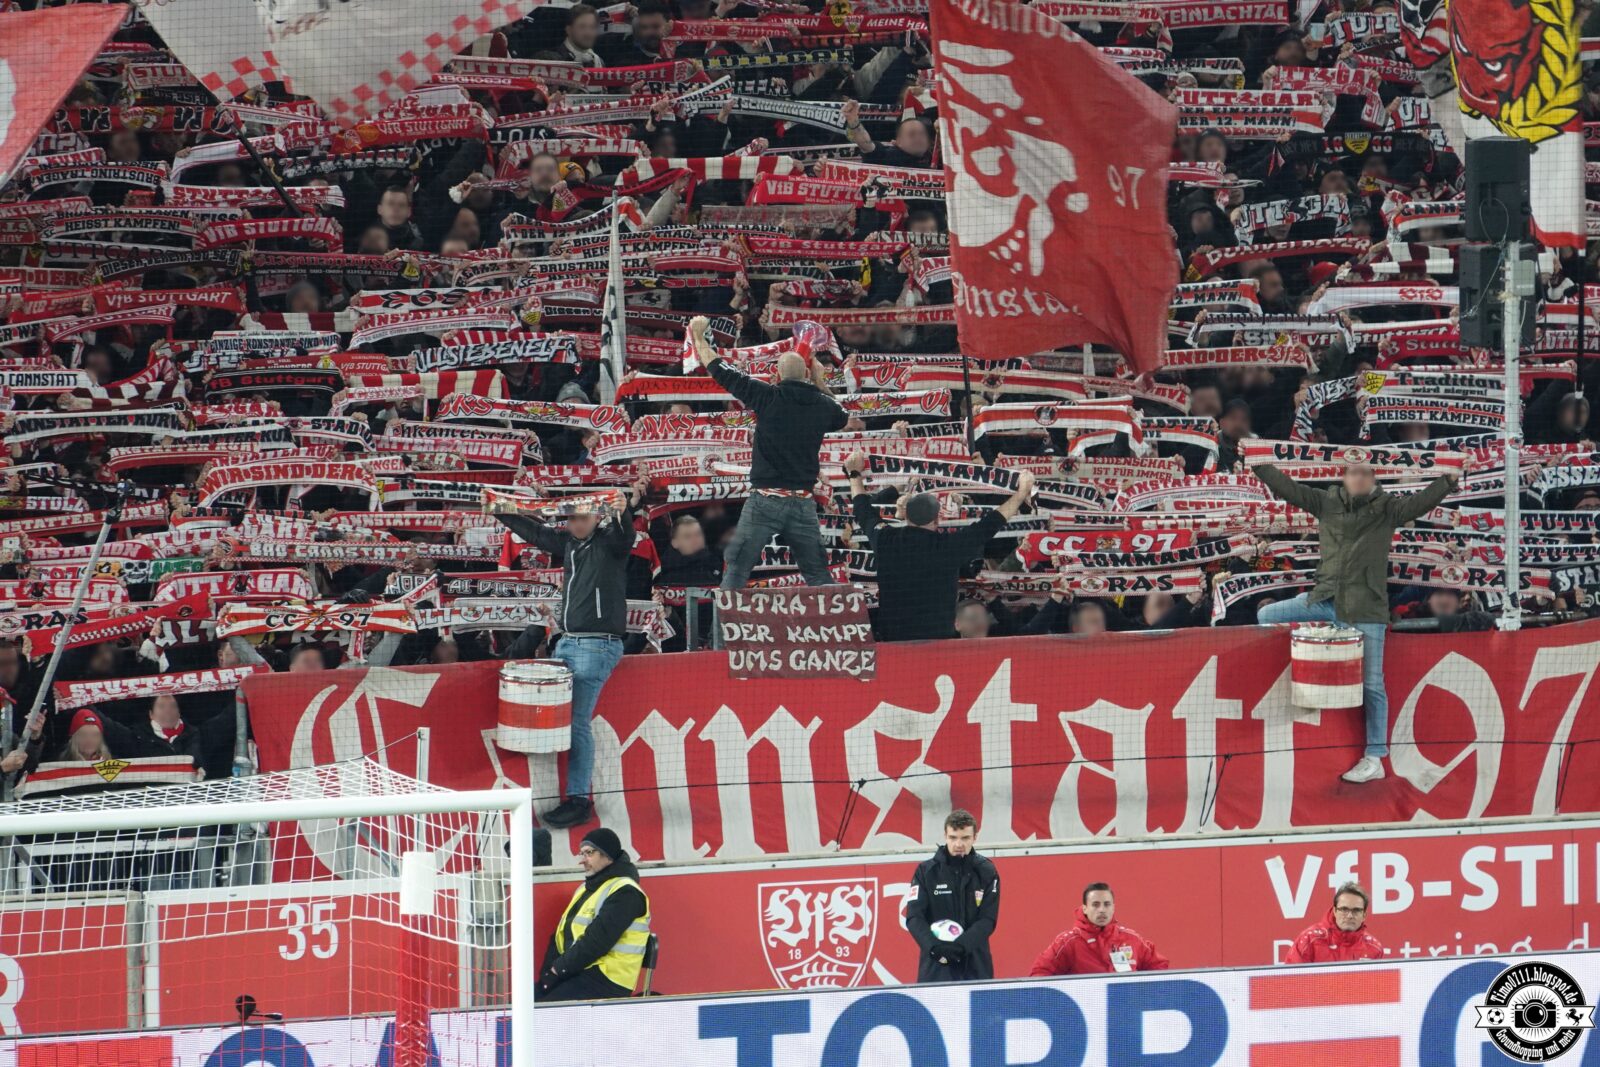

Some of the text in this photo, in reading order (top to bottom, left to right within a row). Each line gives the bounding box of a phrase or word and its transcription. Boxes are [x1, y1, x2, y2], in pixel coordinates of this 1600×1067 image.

[1217, 116, 1237, 127] 12.
[766, 179, 793, 196] VfB
[1108, 164, 1145, 210] 97
[64, 217, 110, 232] HEISST
[754, 240, 910, 252] VfB Stuttgart
[539, 259, 611, 273] BRUSTRIN
[105, 291, 233, 308] VfB STUTTGART
[414, 336, 577, 374] ULLSIEBENELF
[10, 373, 78, 387] CANNSTATT
[240, 373, 339, 389] Stuttgart
[1395, 372, 1501, 389] Tradition
[1411, 386, 1488, 396] wird siegen!
[1376, 409, 1426, 423] HEISST
[251, 464, 305, 482] SIND
[312, 463, 356, 481] DER
[868, 453, 1022, 492] COMMANDO
[1085, 456, 1185, 473] LEIDENSCHAFT
[1092, 467, 1109, 476] IST
[26, 496, 85, 513] STOLZ
[101, 502, 166, 522] KRVE
[251, 543, 288, 557] BAD
[1038, 533, 1178, 556] CC 97
[1078, 539, 1232, 568] COMMANDO
[1107, 574, 1174, 592] RAS
[714, 589, 808, 615] ULTRA
[265, 612, 371, 628] CC 97
[721, 622, 872, 643] DER KAMPF
[728, 649, 876, 675] UMS GANZE
[1390, 641, 1600, 822] 97
[1265, 843, 1600, 920] VfB-STI
[278, 902, 339, 961] 35
[788, 946, 850, 961] 18 93
